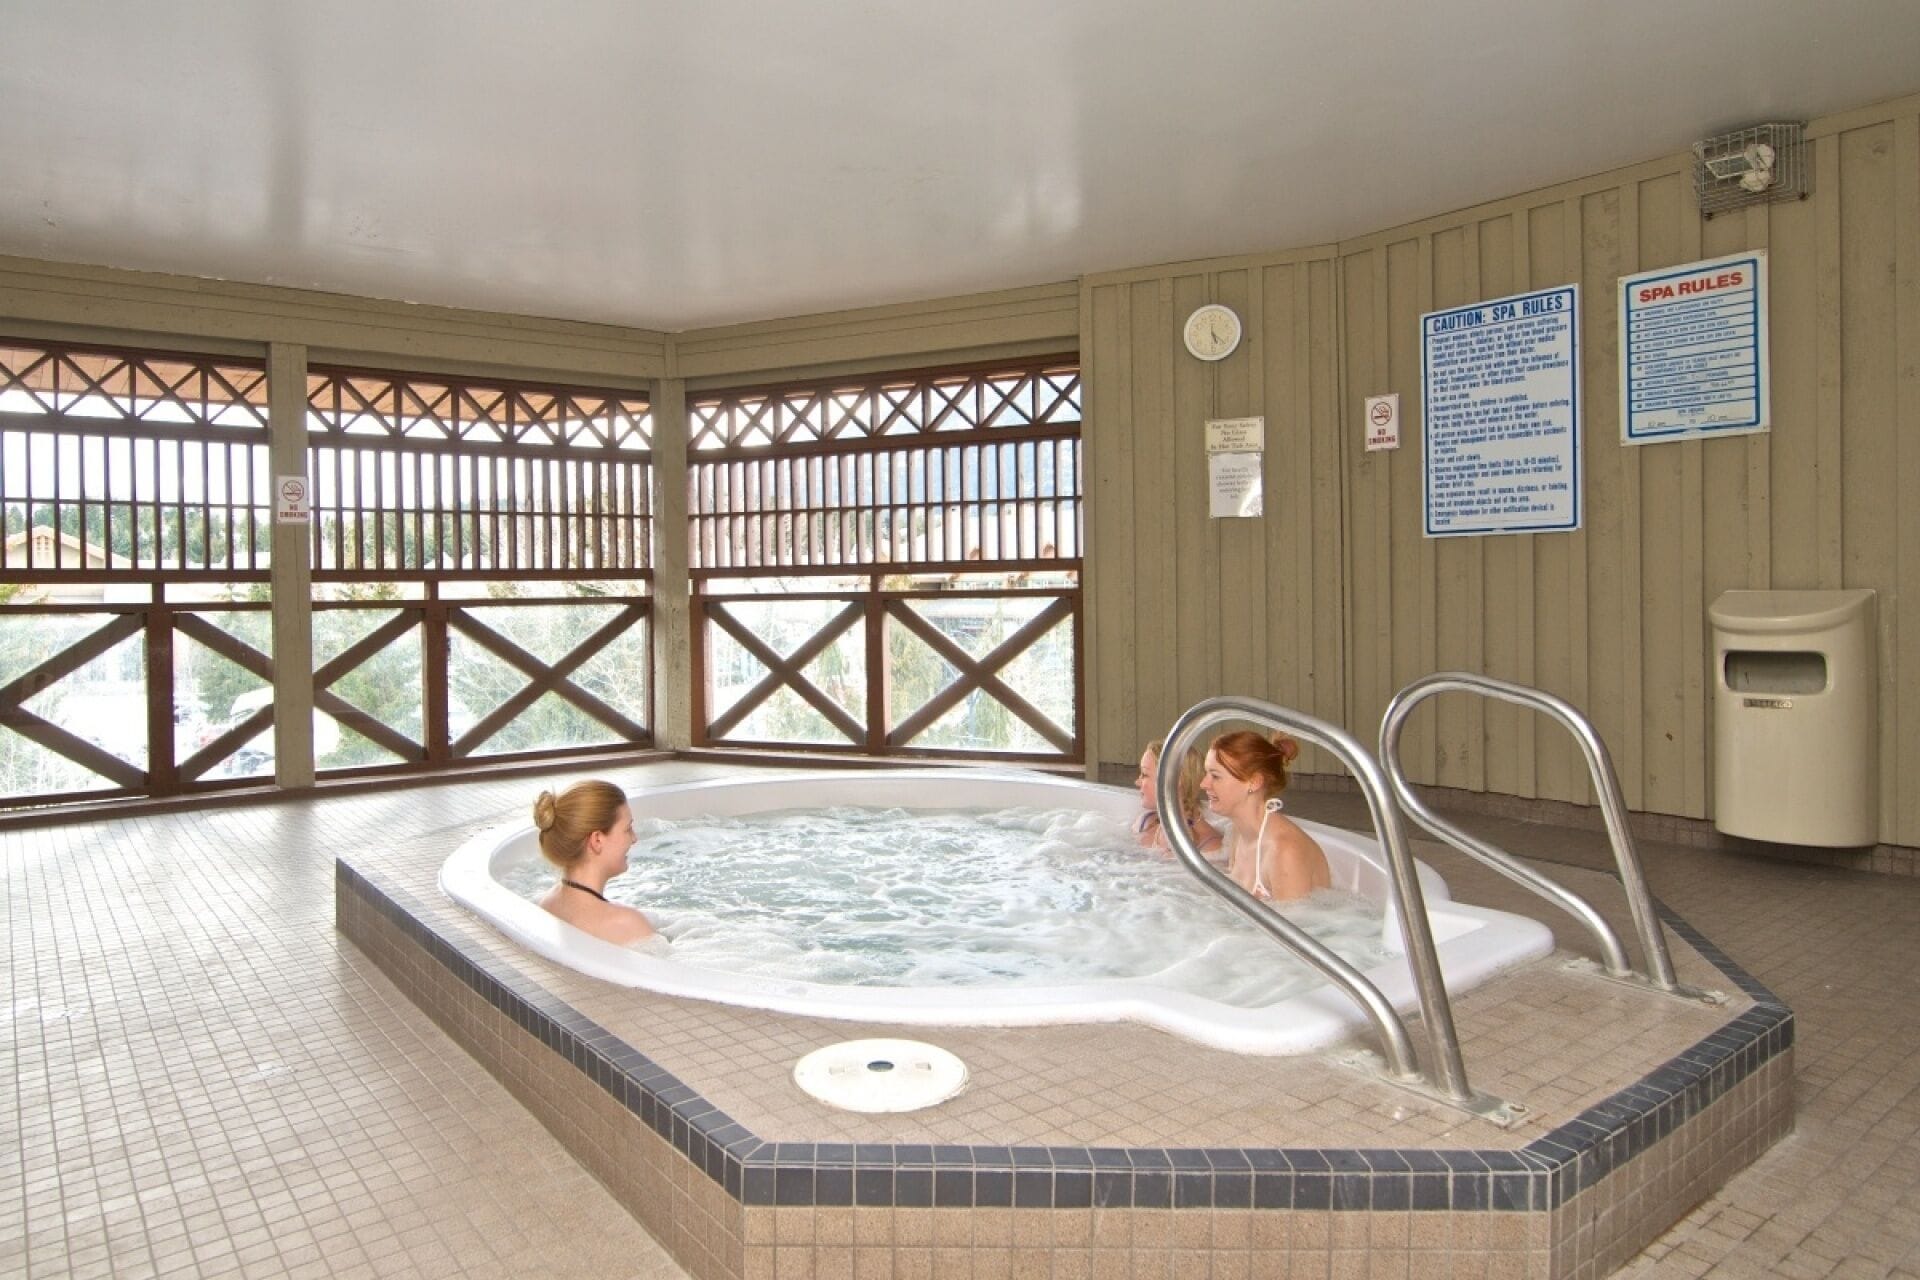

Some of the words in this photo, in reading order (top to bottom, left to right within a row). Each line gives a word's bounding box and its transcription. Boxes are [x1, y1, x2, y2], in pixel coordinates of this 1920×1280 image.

[1640, 285, 1674, 303] SPA
[1679, 272, 1743, 295] RULES
[1433, 310, 1486, 332] CAUTION:
[1493, 306, 1515, 320] SPA
[1523, 296, 1562, 315] RULES
[1368, 436, 1395, 445] SMOKING
